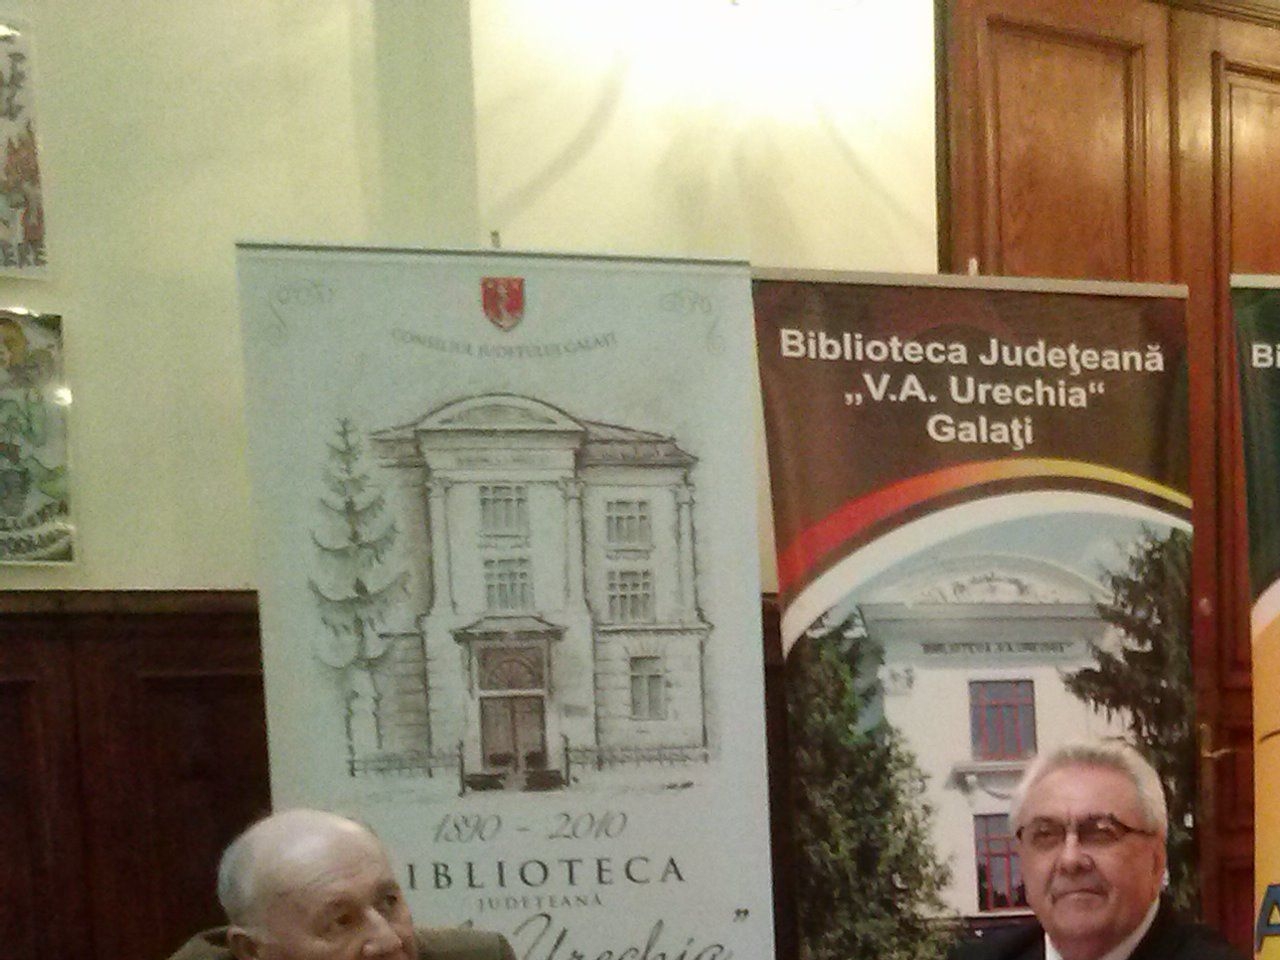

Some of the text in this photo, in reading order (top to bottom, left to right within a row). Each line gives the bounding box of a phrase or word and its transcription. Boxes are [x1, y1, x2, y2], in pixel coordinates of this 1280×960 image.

[780, 328, 1165, 375] Biblioteca Judeţeană
[926, 413, 1034, 450] Galaţi
[433, 812, 502, 844] 1890
[548, 811, 629, 840] 2010
[406, 855, 687, 891] IBLIOTECA
